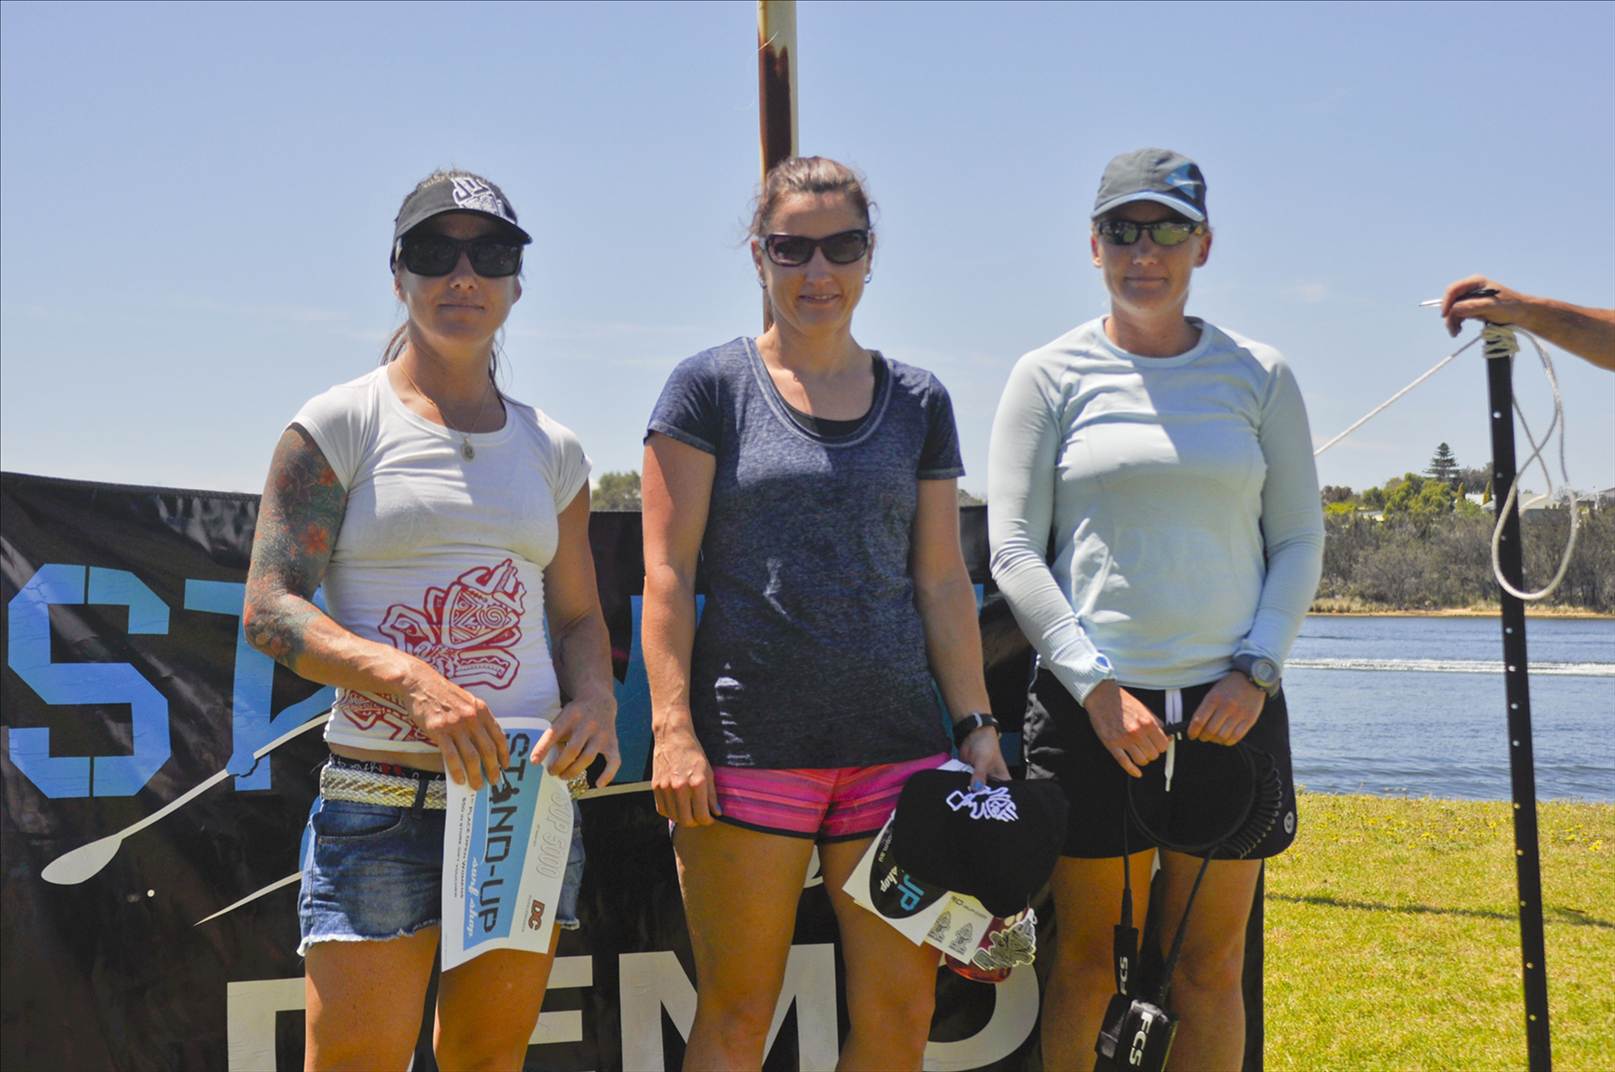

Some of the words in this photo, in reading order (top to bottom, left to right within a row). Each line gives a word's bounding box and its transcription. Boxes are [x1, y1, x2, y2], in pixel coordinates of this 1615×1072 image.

[468, 856, 480, 896] surf
[467, 897, 480, 938] shop
[527, 899, 546, 931] DC
[1129, 1011, 1154, 1067] FCS
